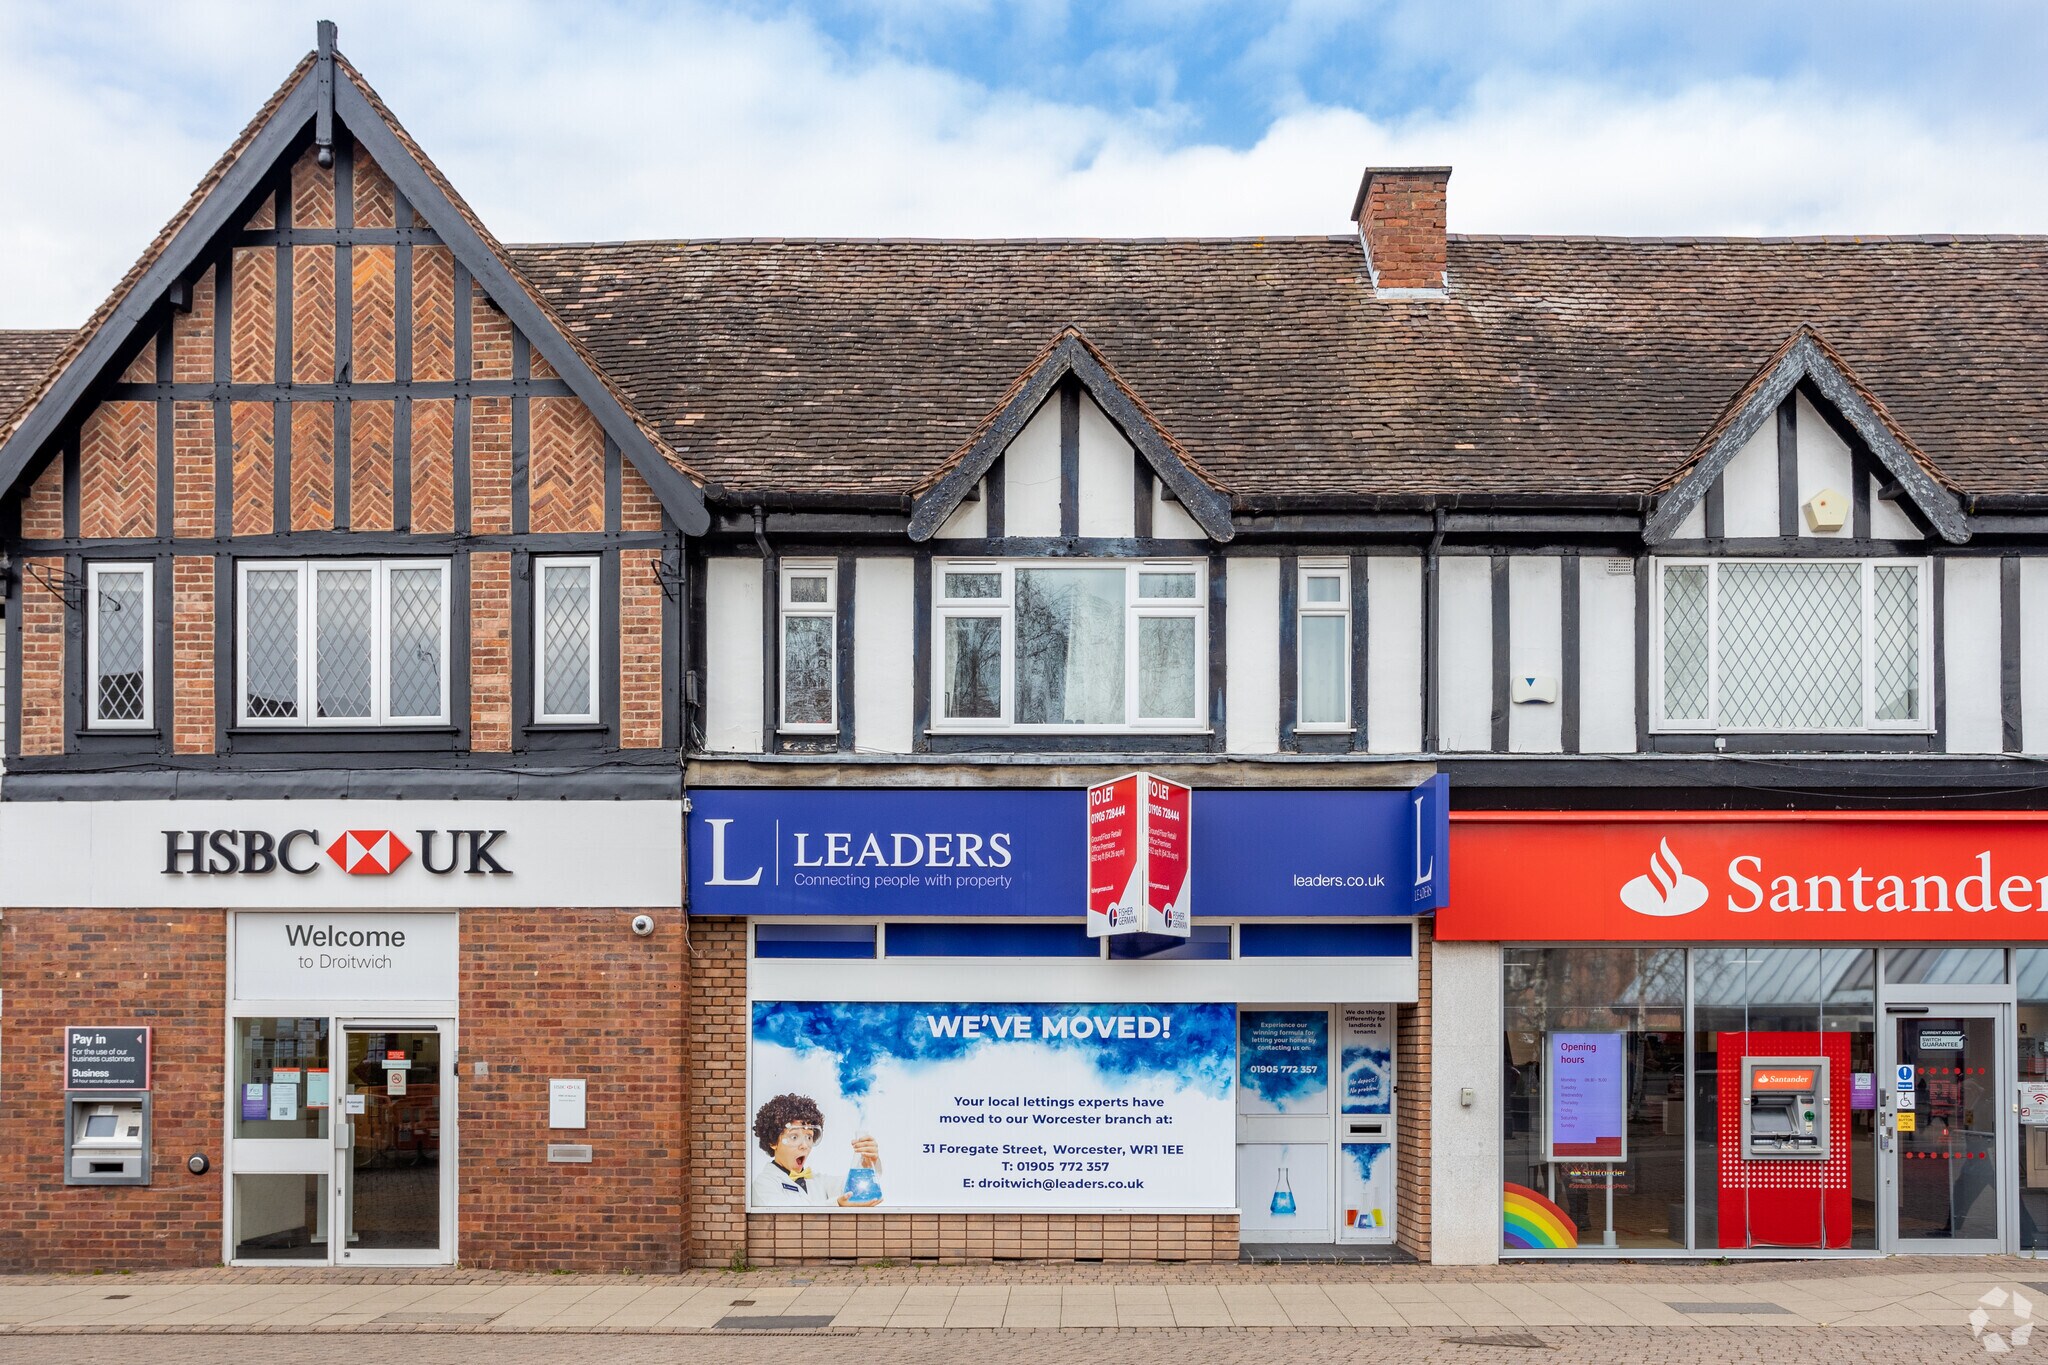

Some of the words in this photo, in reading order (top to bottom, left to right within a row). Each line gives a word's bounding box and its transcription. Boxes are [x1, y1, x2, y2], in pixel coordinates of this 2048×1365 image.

[1091, 789, 1102, 806] TO
[1102, 786, 1114, 803] LET
[1147, 780, 1158, 797] TO
[1158, 783, 1169, 800] LET
[1091, 811, 1105, 824] 01905
[1414, 796, 1433, 886] L
[161, 829, 321, 875] HSBC
[416, 830, 513, 875] UK
[704, 818, 763, 886] L
[794, 832, 1012, 868] LEADERS
[794, 873, 870, 889] Connecting
[874, 874, 920, 889] people
[924, 874, 952, 886] with
[956, 874, 1012, 889] property
[1293, 874, 1385, 888] leaders.co.uk
[1414, 885, 1432, 902] LEADERS
[1119, 907, 1133, 916] FISHER
[1173, 911, 1184, 920] FISHER
[1119, 916, 1137, 926] GERMAN
[1173, 920, 1188, 929] GERMAN
[286, 924, 406, 948] Welcome
[298, 955, 313, 969] to
[320, 953, 392, 969] Droitwich
[927, 1015, 1032, 1038] WE’VE
[1042, 1016, 1172, 1039] MOVED!
[72, 1034, 92, 1046] Pay
[96, 1034, 106, 1044] in
[1257, 1044, 1292, 1052] contacting
[1560, 1043, 1597, 1052] Opening
[1560, 1056, 1584, 1064] hours
[72, 1069, 109, 1077] Business
[1250, 1065, 1278, 1074] 01905
[1280, 1065, 1298, 1074] 772
[1300, 1065, 1318, 1074] 357
[954, 1096, 984, 1107] Your
[988, 1096, 1020, 1107] local
[1024, 1096, 1074, 1109] lettings
[1078, 1097, 1129, 1110] experts
[1132, 1096, 1164, 1107] have
[939, 1113, 984, 1124] moved
[988, 1114, 1002, 1124] to
[1006, 1116, 1028, 1124] our
[1032, 1114, 1101, 1124] Worcester
[1104, 1113, 1151, 1124] branch
[1156, 1114, 1173, 1124] at:
[922, 1144, 936, 1154] 31
[939, 1144, 998, 1156] Foregate
[1002, 1144, 1047, 1156] Street,
[1052, 1144, 1126, 1156] Worcester,
[1130, 1145, 1158, 1155] WR1
[1163, 1145, 1184, 1155] 1EE
[1002, 1162, 1014, 1172] T:
[1016, 1162, 1054, 1172] 01905
[1060, 1162, 1084, 1172] 772
[1086, 1162, 1110, 1172] 357
[1582, 1168, 1626, 1176] Santander
[962, 1179, 975, 1188] E:
[978, 1178, 1144, 1191] droitwich@leaders.co.uk
